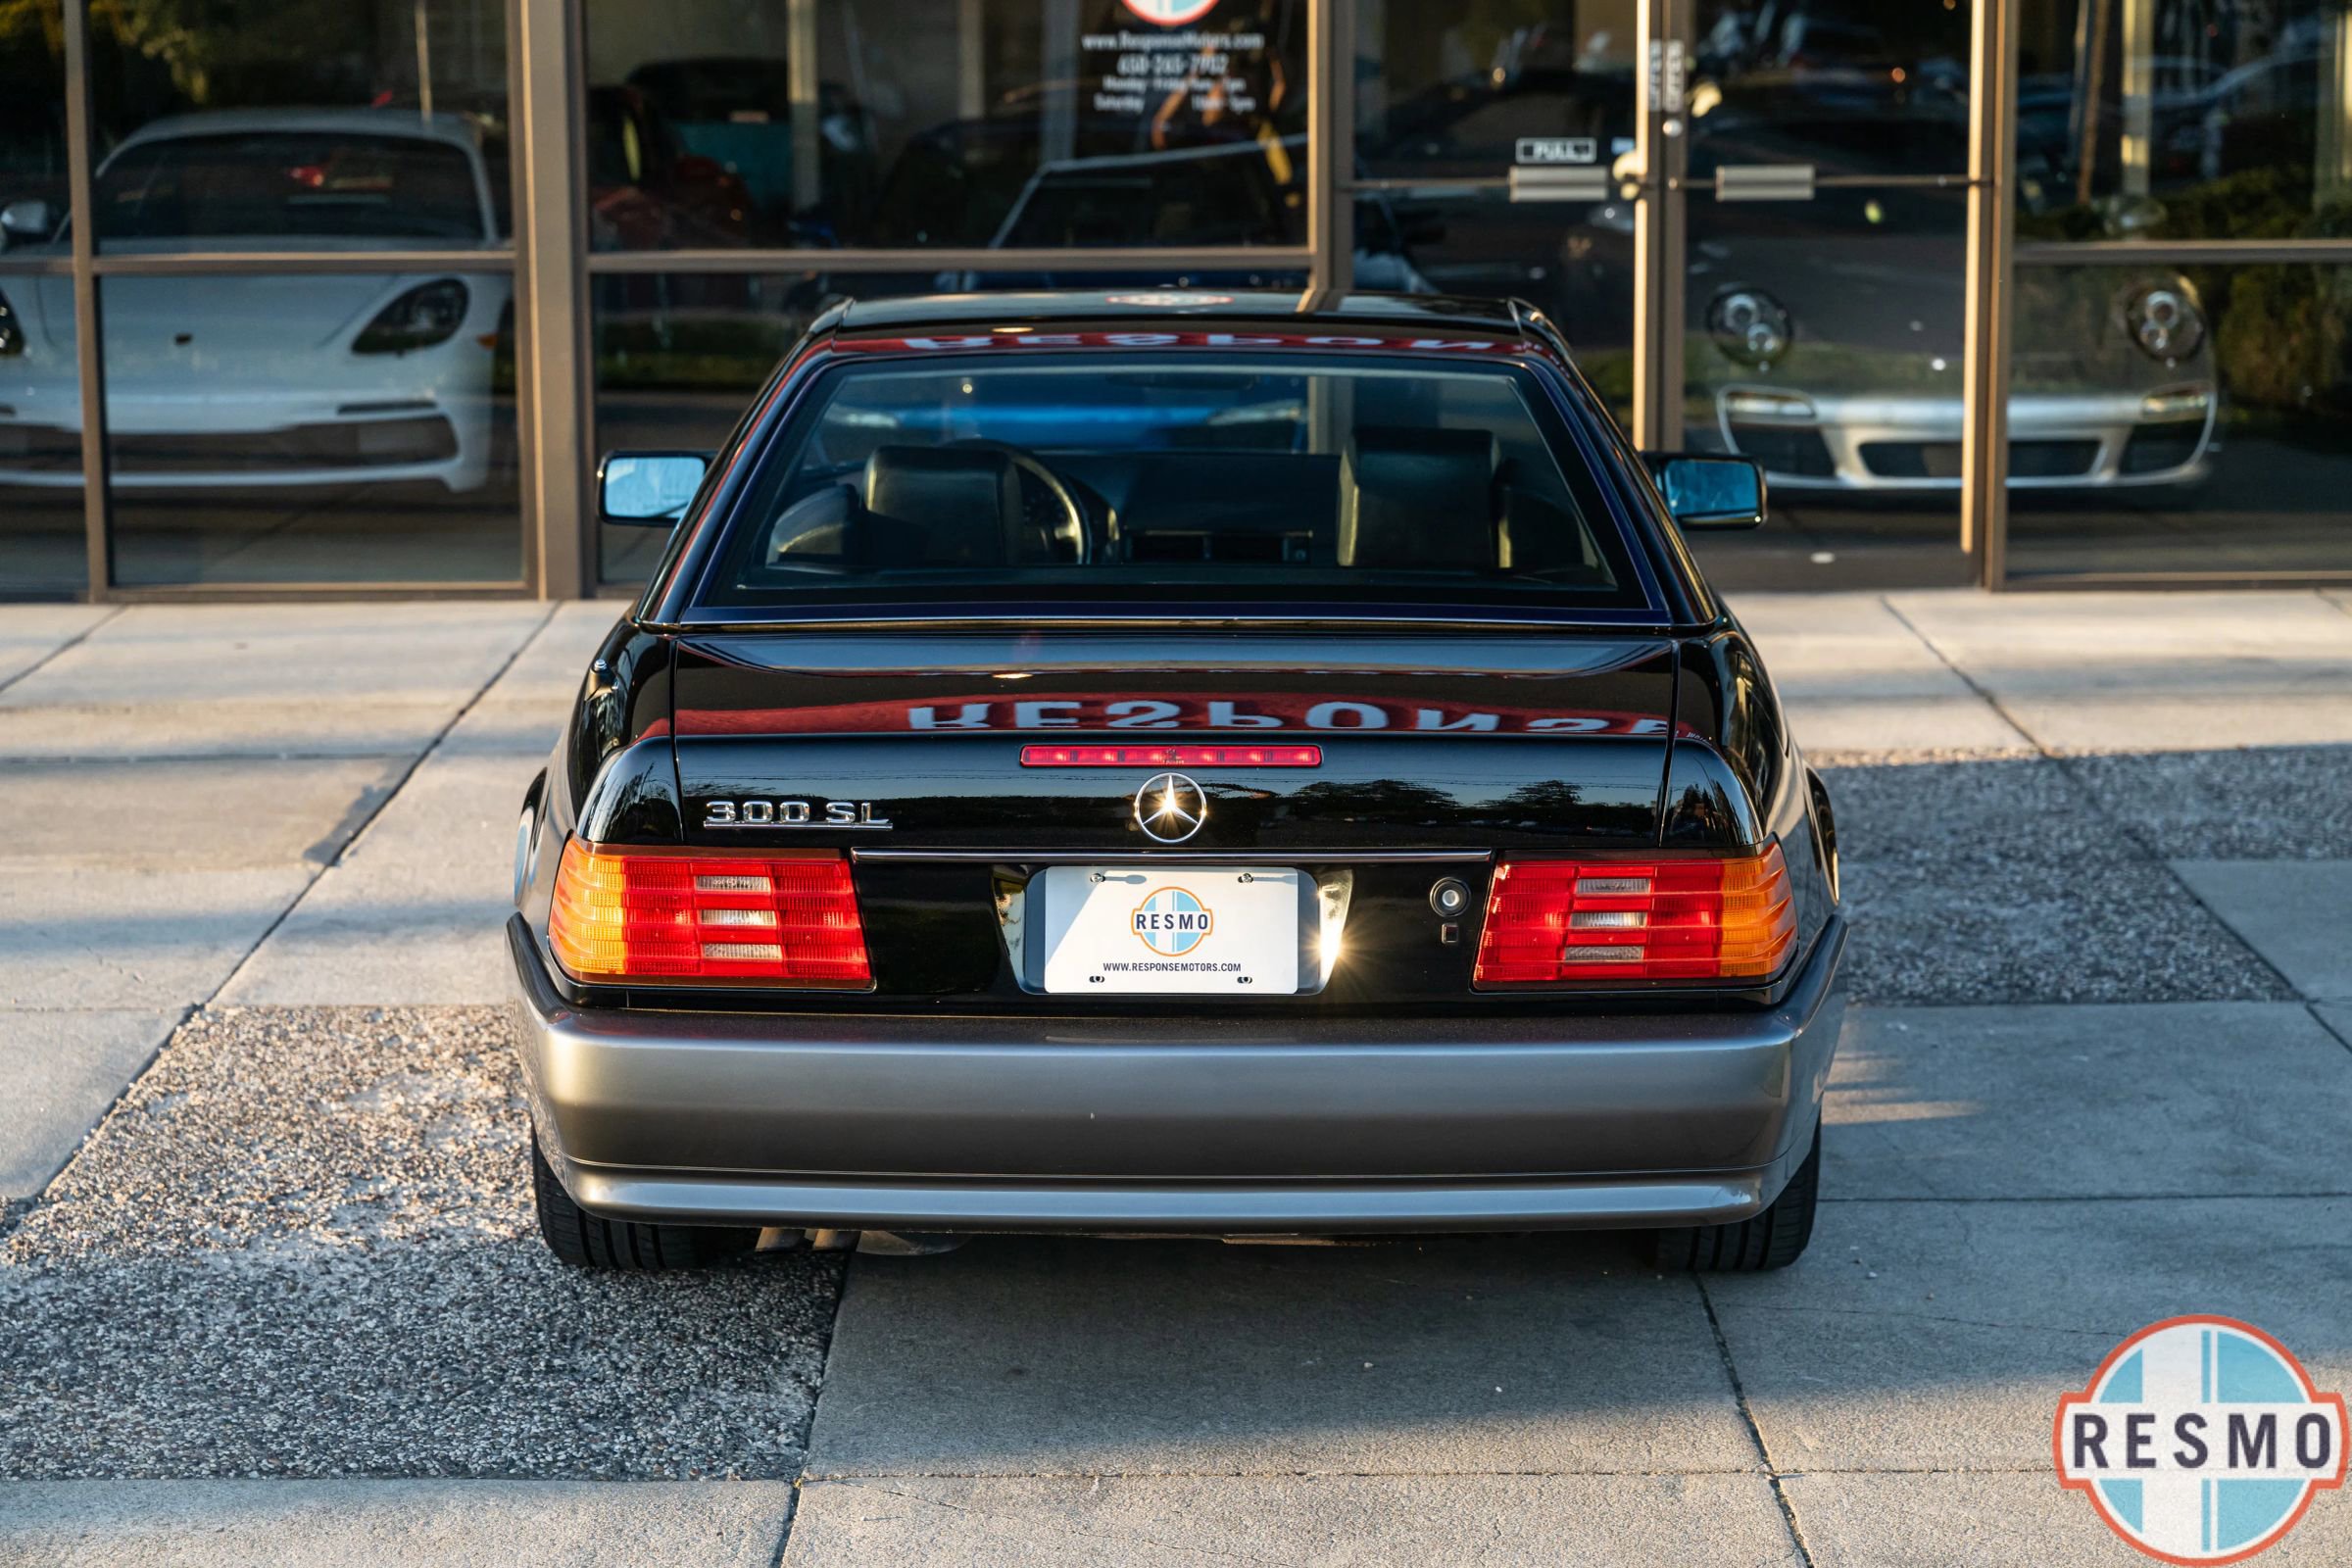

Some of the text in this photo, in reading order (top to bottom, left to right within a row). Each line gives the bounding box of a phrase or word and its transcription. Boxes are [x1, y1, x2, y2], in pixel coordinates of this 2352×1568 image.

[706, 801, 890, 824] 300 SL
[1136, 913, 1208, 930] RESMO
[1102, 962, 1241, 972] WWW.RESPONSEMOTORS.COM
